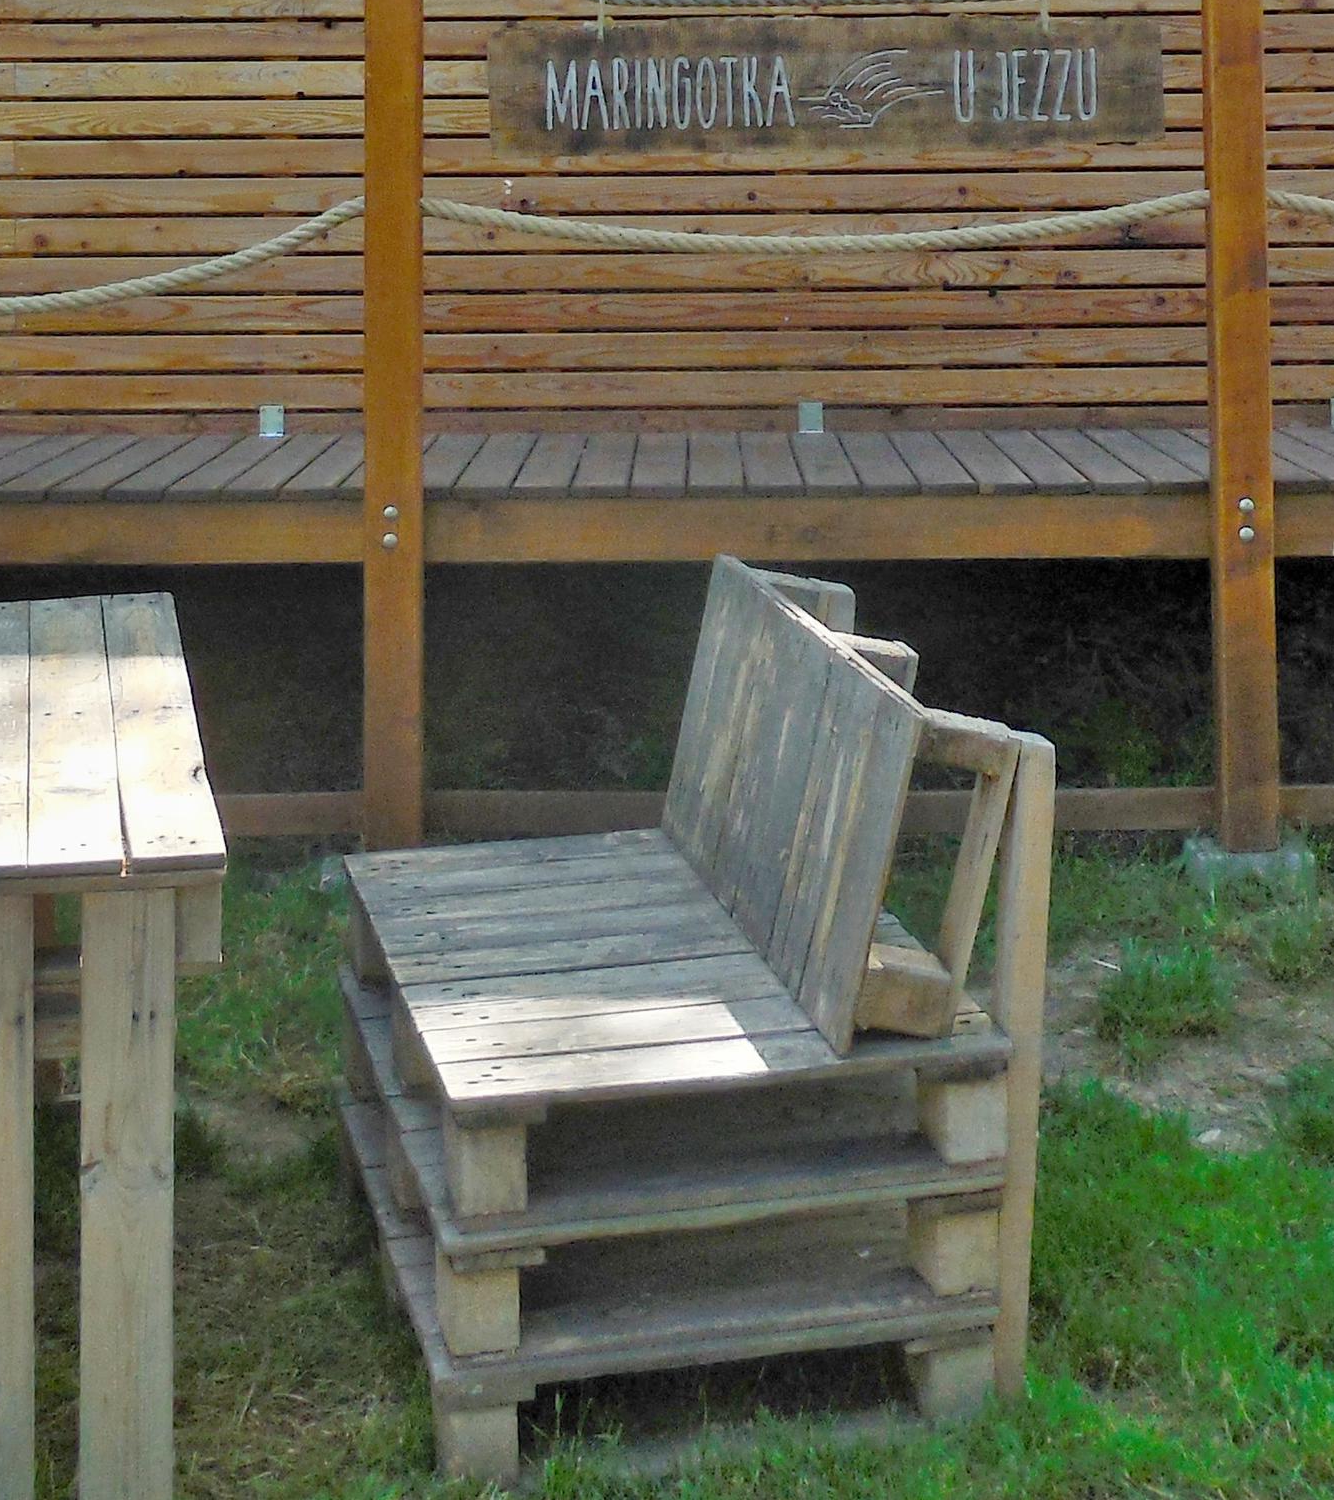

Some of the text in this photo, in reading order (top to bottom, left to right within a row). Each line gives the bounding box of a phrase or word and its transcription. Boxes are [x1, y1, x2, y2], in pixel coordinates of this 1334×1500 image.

[546, 47, 1097, 131] MARINGOTKA U JEZZU
